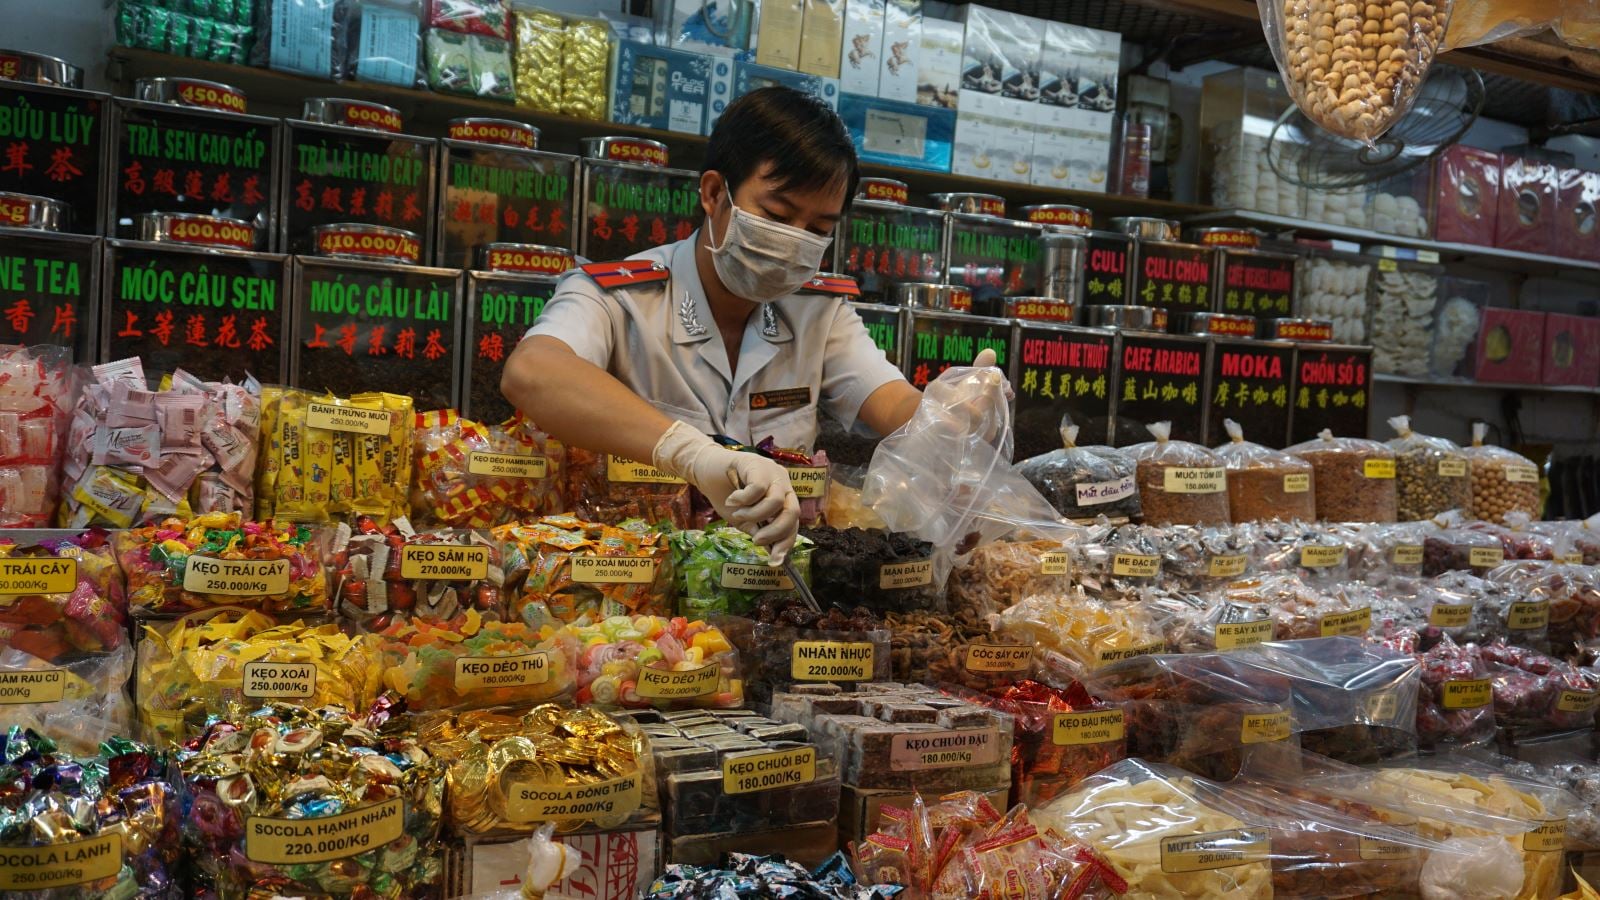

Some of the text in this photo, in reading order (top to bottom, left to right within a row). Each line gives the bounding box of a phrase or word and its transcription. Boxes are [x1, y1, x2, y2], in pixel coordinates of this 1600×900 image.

[127, 120, 265, 168] TRÀ SEN CAO CẤP
[298, 140, 327, 178] TRÀ
[361, 152, 389, 185] CAO
[393, 150, 423, 187] CẤP
[322, 234, 420, 260] 410.000/kg
[1091, 249, 1125, 278] CULI
[1145, 255, 1174, 282] CULI
[34, 259, 80, 296] TEA
[121, 260, 275, 311] MÓC CÂU SEN
[310, 274, 449, 322] MÓC CÂU LÀI
[4, 299, 77, 337] 香片
[482, 293, 519, 330] ĐỌT
[118, 309, 273, 351] 上等蓮花茶
[916, 327, 972, 365] TRÀ BÔNG
[1023, 338, 1045, 364] CAFE
[1123, 345, 1200, 377] CAFE ARABICA
[1222, 352, 1288, 379] MOKA
[1301, 353, 1365, 386] CHỒN SỐ 8
[312, 404, 335, 417] BÁNH
[330, 418, 369, 430] 250.000/Kg
[407, 549, 484, 564] KẸO SÂM HQ
[575, 558, 594, 569] KẸO
[4, 561, 70, 575] TRÁI CÂY
[192, 561, 286, 579] KẸO TRÁI CÂY
[421, 564, 472, 577] 270.000/Kg
[595, 569, 634, 580] 250.000/Kg
[726, 566, 778, 577] KẸO CHANH
[207, 580, 267, 592] 250.000/Kg
[743, 577, 781, 587] 250.000/Kg
[840, 647, 872, 664] NHỤC
[1013, 653, 1031, 663] CAY
[251, 668, 310, 682] KẸO XOÀI
[462, 658, 544, 676] KẸO DẺO THÚ
[808, 665, 864, 678] 220.000/Kg
[21, 674, 43, 684] RAU
[251, 681, 309, 693] 250.000/Kg
[482, 673, 526, 685] 180.000/Kg
[644, 672, 670, 686] KẸO
[1059, 719, 1080, 731] KẸO
[906, 738, 930, 752] KẸO
[921, 752, 972, 766] 180.000/Kg
[729, 761, 755, 776] KẸO
[737, 771, 802, 791] 180.000/Kg
[520, 788, 573, 801] SOCOLA
[575, 782, 610, 799] ĐỒNG
[542, 800, 614, 816] 220.000/Kg
[255, 804, 396, 838] SOCOLA HẠNH NHÂN
[65, 842, 111, 864] LẠNH
[285, 833, 370, 856] 220.000/Kg
[12, 867, 83, 883] 250.000/Kg
